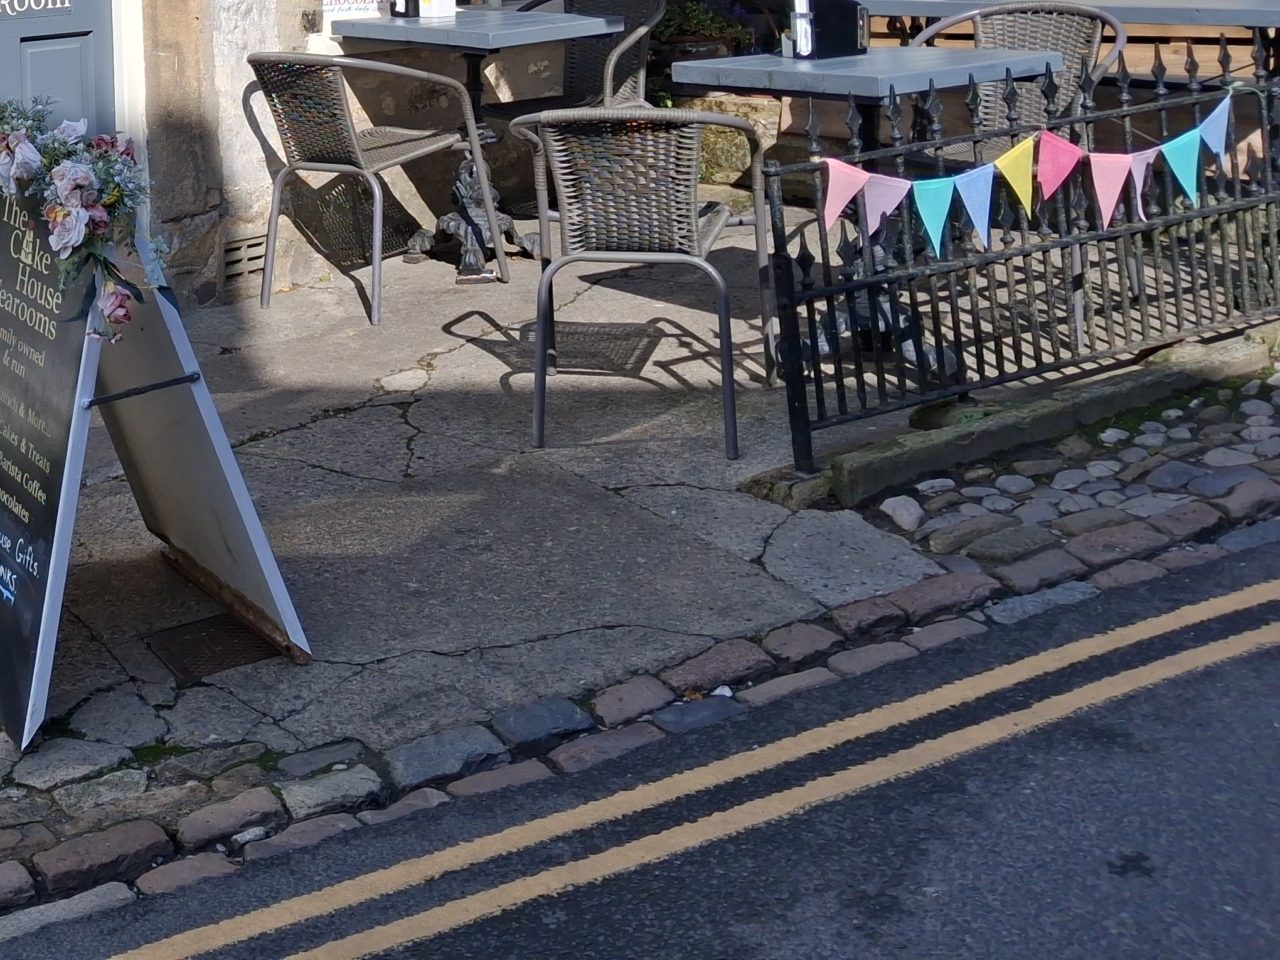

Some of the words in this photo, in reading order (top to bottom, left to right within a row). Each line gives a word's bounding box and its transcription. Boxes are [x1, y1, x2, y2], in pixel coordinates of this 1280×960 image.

[3, 194, 29, 231] The
[15, 263, 62, 314] House
[2, 349, 10, 367] &
[11, 359, 26, 378] run
[17, 340, 46, 367] owned
[26, 442, 51, 474] Treats
[22, 473, 47, 506] Coffee
